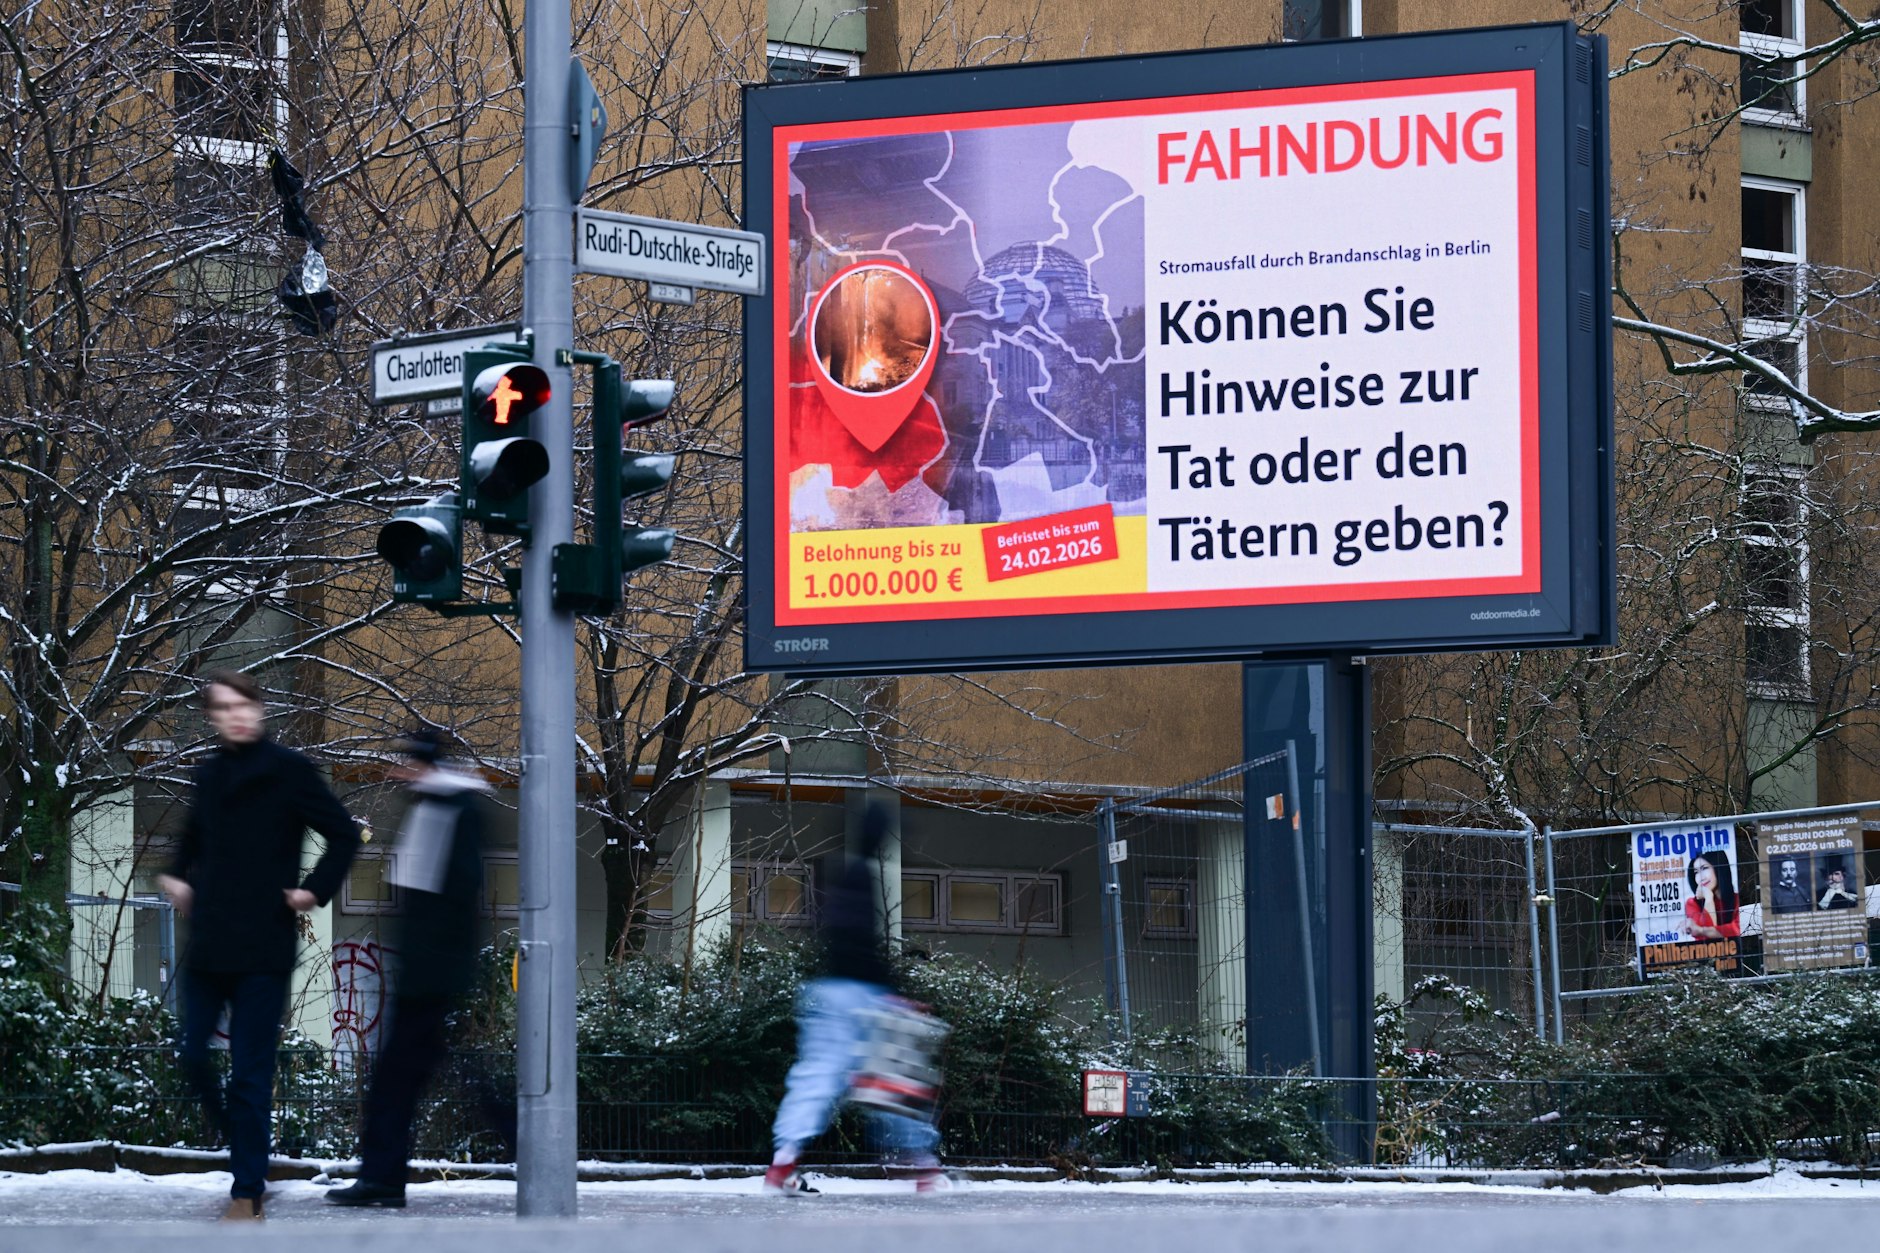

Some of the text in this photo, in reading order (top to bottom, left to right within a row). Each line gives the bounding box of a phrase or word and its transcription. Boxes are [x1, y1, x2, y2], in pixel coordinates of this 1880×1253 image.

[1158, 108, 1504, 185] FAHNDUNG
[586, 223, 753, 278] Rudi-Dutschke-Straße
[1159, 240, 1491, 275] Stromausfall durch Brandanschlag in Berlin
[1160, 286, 1435, 346] Können Sie
[387, 351, 462, 382] Charlotten
[1160, 361, 1479, 418] Hinweise zur
[1158, 431, 1467, 490] Tat oder den
[997, 519, 1100, 549] Befristet bis zum
[1158, 500, 1509, 567] Tätern geben?
[804, 540, 962, 564] Belohnung bis zu
[1001, 536, 1103, 572] 24.02.2026
[804, 567, 963, 599] 1.000.000 €
[1470, 607, 1541, 622] outdoormedia.de
[774, 638, 829, 653] STRÖER
[1760, 816, 1858, 832] Die große Neujahrsgala 2026
[1637, 826, 1730, 860] Chopin
[1766, 838, 1853, 854] 02.01.2026 um 18h
[1640, 882, 1680, 904] 9.1.2026
[1650, 901, 1682, 914] Fr 20:00
[1644, 937, 1738, 965] Philharmonie
[1645, 930, 1679, 944] Sachiko
[1094, 1076, 1101, 1085] H
[1126, 1077, 1133, 1088] S
